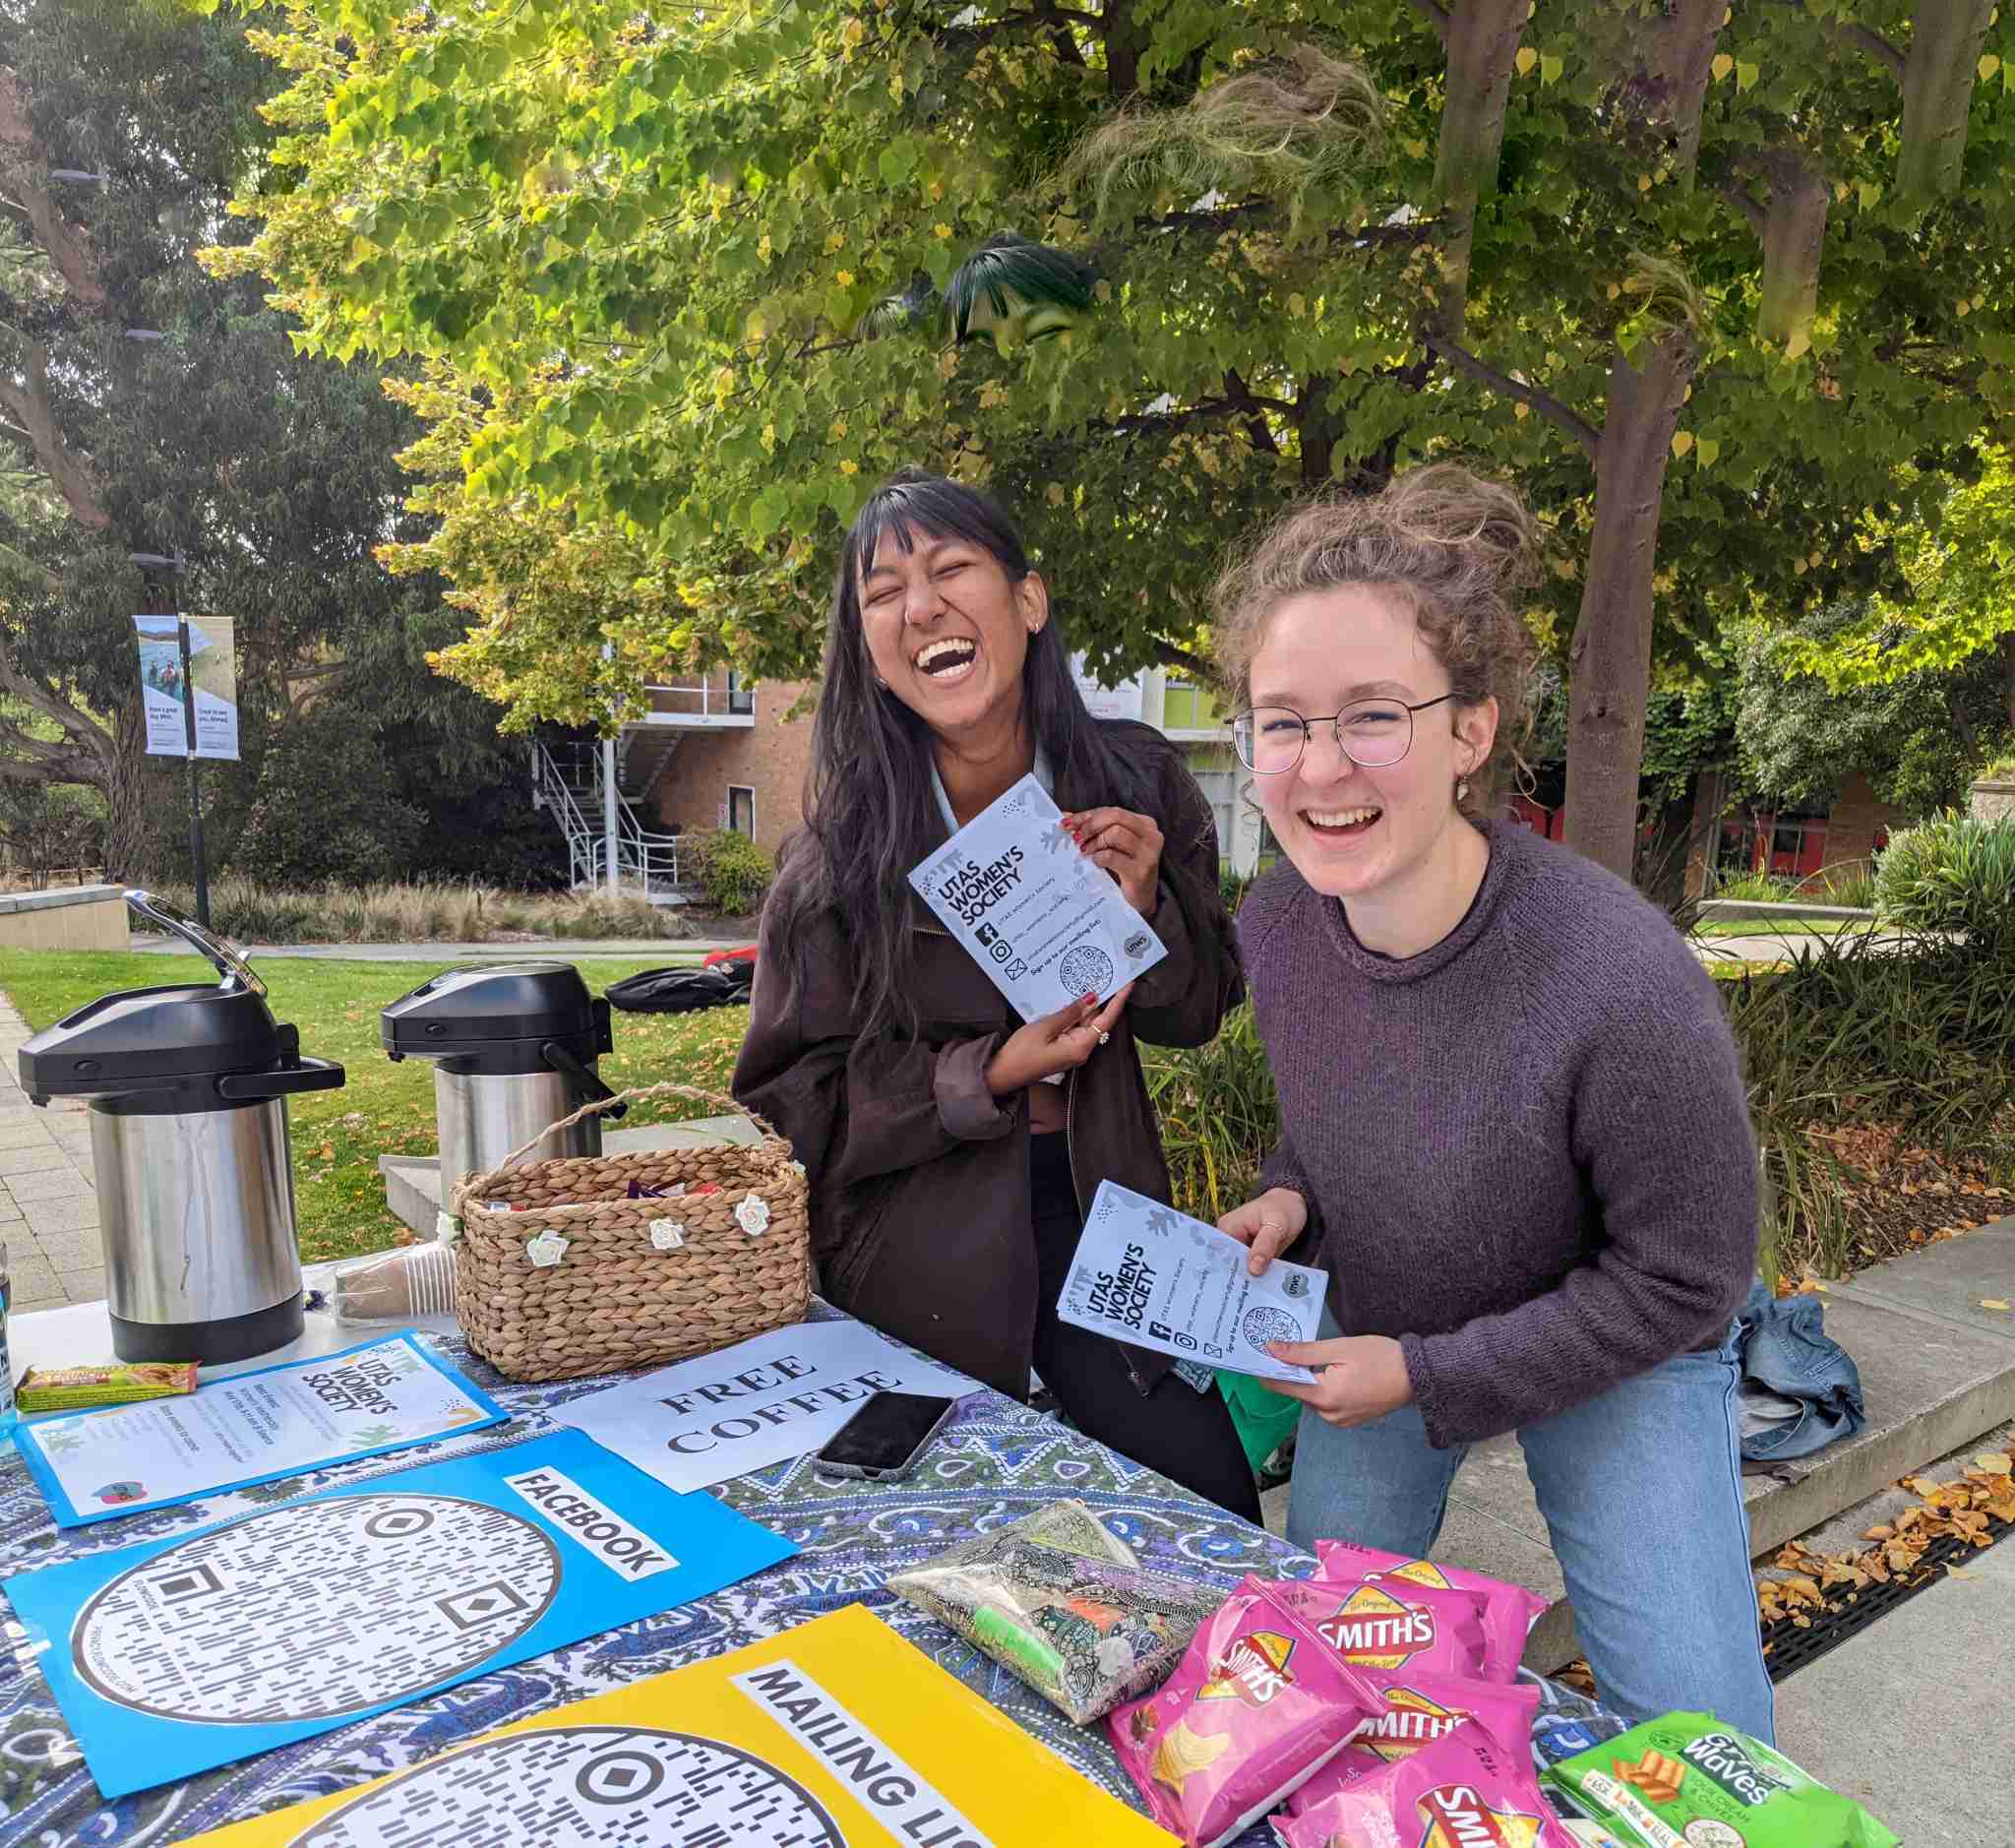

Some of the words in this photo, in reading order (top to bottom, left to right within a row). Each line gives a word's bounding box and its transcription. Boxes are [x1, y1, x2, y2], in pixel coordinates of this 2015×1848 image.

[938, 860, 980, 899] UTAS
[948, 845, 1023, 912] WOMEN'S
[961, 867, 1021, 926] SOCIETY
[1086, 1270, 1114, 1313] UTAS
[1105, 1243, 1143, 1321] WOMEN'S
[1124, 1262, 1156, 1329] SOCIETY
[301, 1373, 363, 1413] SOCIETY
[331, 1366, 398, 1414] WOMEN'S
[357, 1358, 401, 1386] UTAS
[657, 1354, 817, 1416] FREE
[667, 1370, 903, 1453] COFFEE
[513, 1474, 666, 1573] FACEBOOK
[1316, 1612, 1433, 1649] SMITH'S
[1218, 1639, 1285, 1702] SMITH'S
[748, 1668, 917, 1807] MAILING
[1683, 1738, 1769, 1806] Waves
